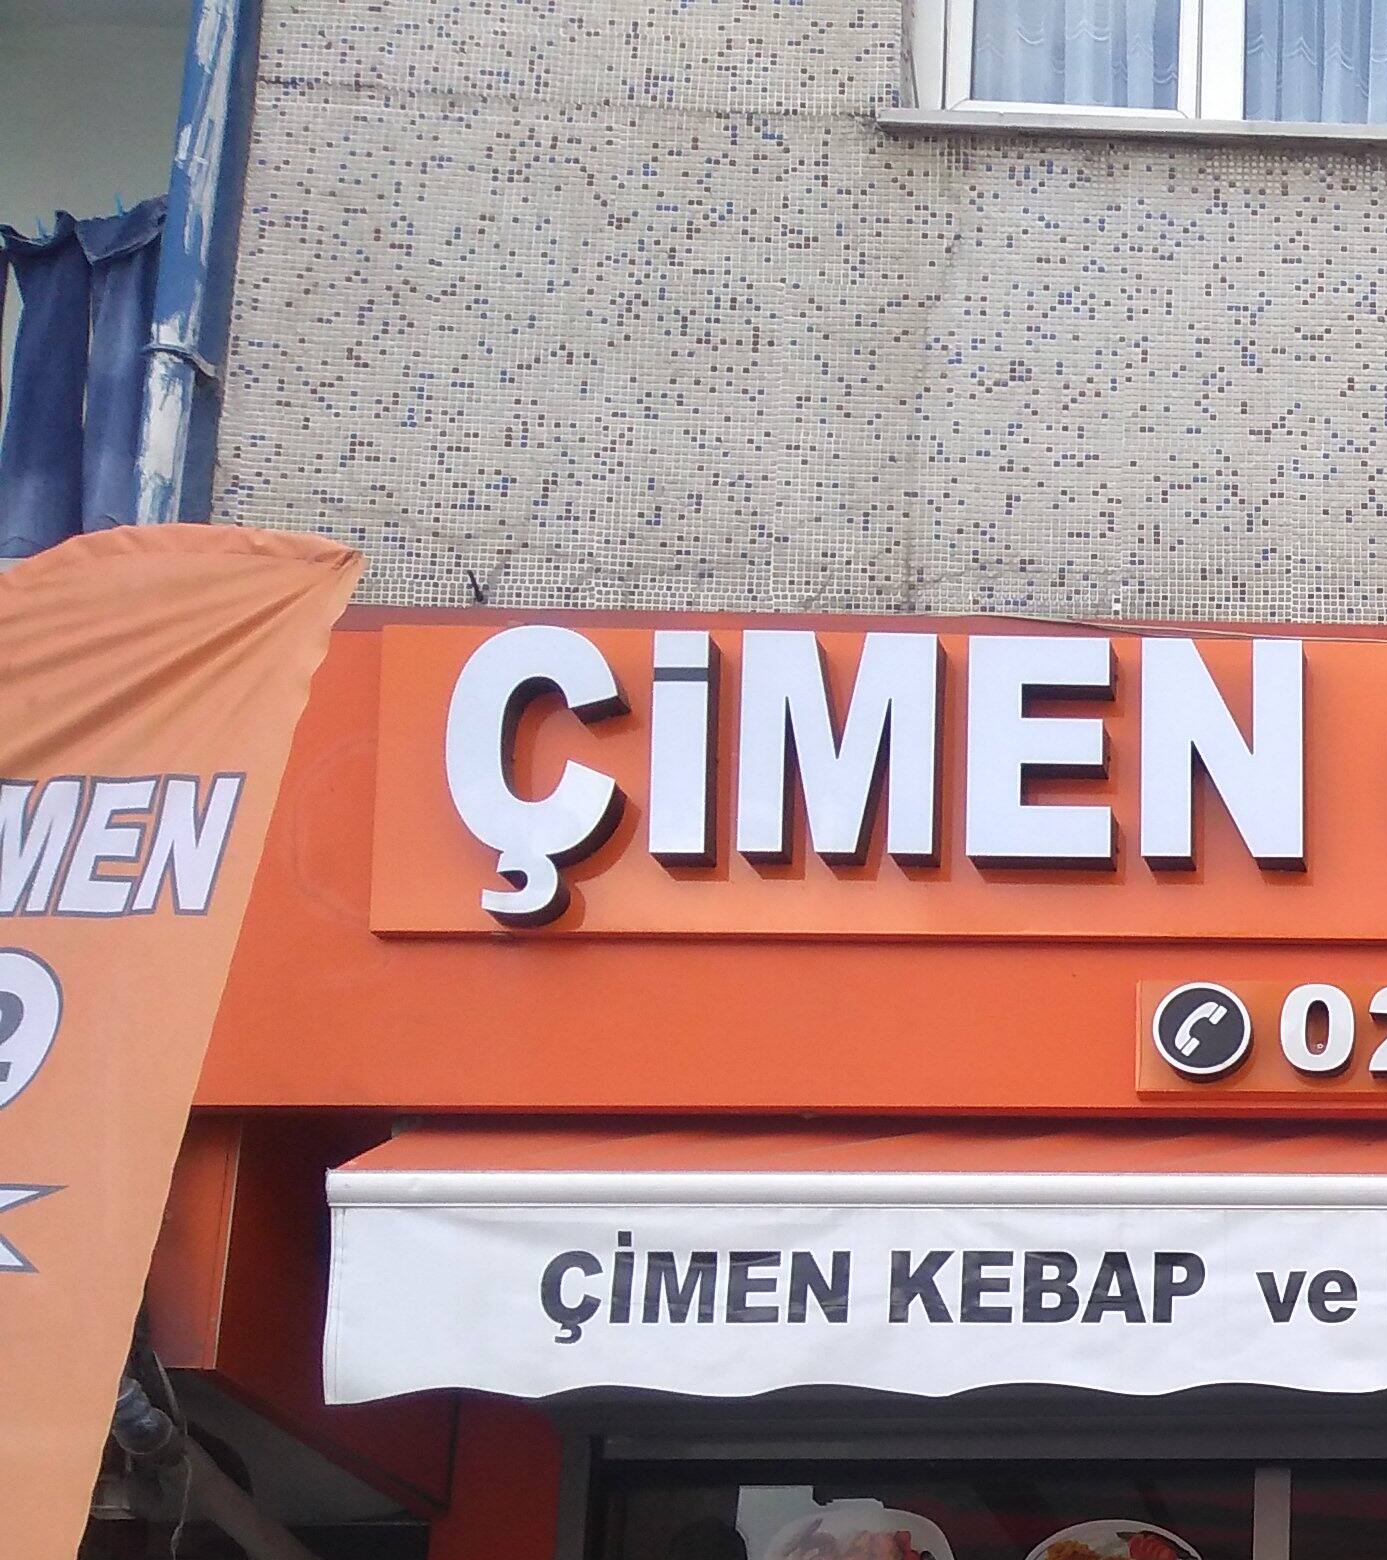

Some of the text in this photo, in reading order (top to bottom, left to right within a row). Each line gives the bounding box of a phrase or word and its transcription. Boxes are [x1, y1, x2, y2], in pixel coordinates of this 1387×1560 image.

[0, 771, 246, 917] MEN
[540, 1231, 851, 1343] ÇİMEN
[888, 1249, 1206, 1324] KEBAP
[1256, 1269, 1358, 1324] ve
